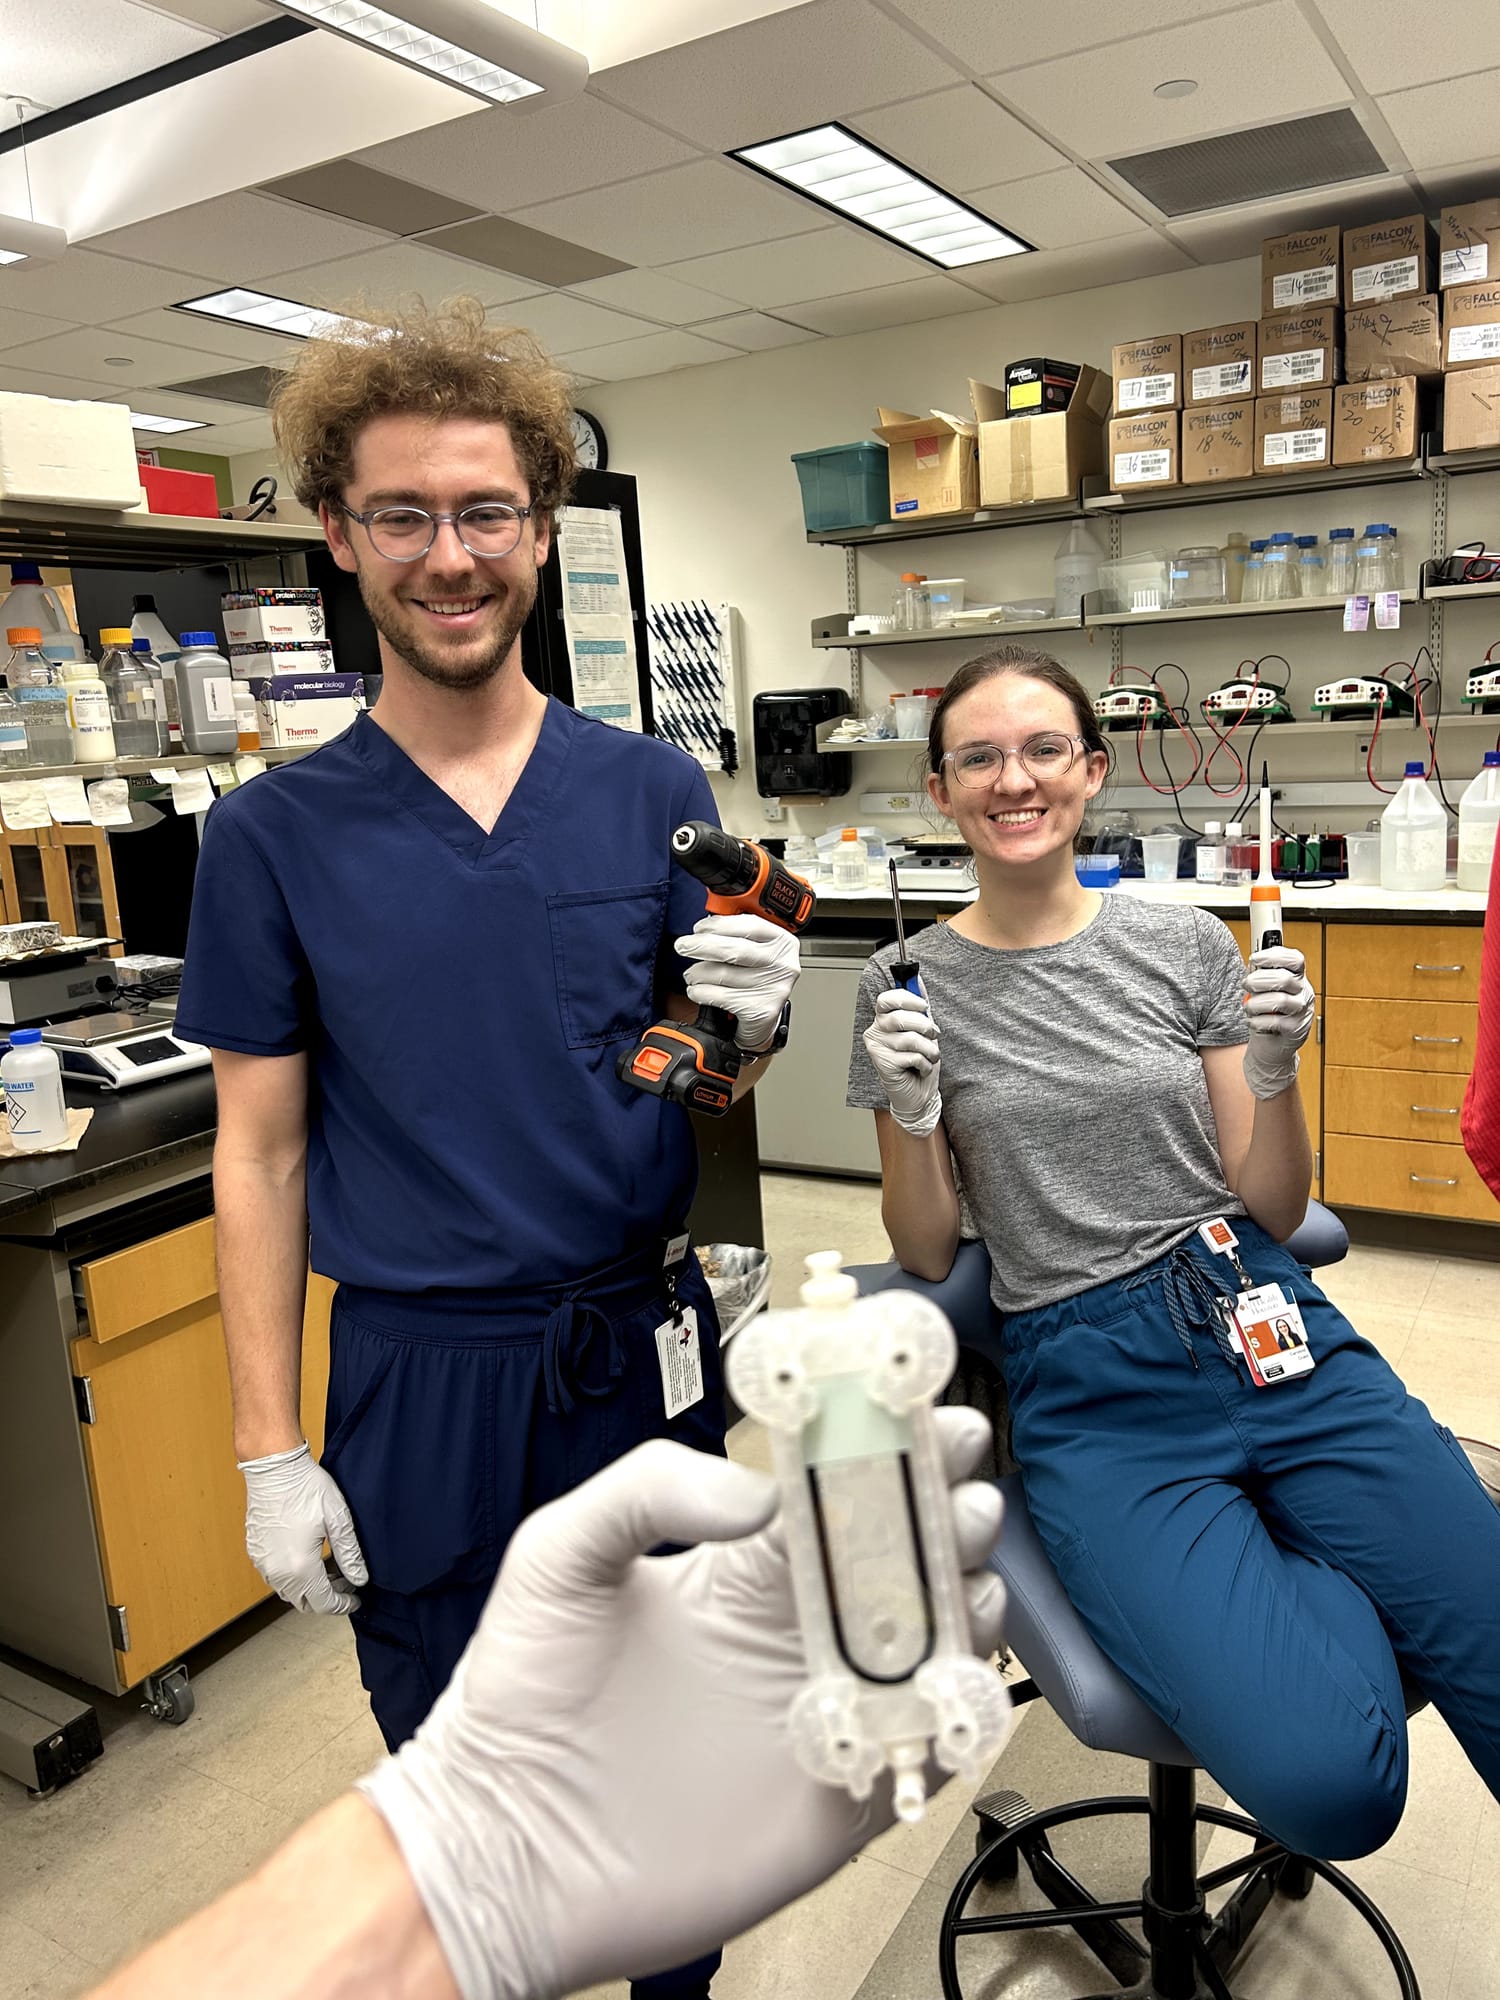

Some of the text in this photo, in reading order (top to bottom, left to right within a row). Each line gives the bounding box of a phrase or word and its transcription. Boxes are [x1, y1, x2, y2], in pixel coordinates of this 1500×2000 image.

[1370, 225, 1414, 242] FALCON
[1287, 235, 1328, 250] FALCON
[1283, 317, 1323, 332] FALCON
[1207, 331, 1245, 346] FALCON
[1135, 343, 1172, 358] FALCON
[1360, 387, 1402, 400] FALCON
[1282, 398, 1321, 412] FALCON
[1205, 410, 1244, 424] FALCON
[1343, 410, 1363, 425] 20
[1132, 420, 1168, 434] FALCON
[585, 430, 591, 441] 2
[589, 444, 596, 456] 3
[1196, 434, 1213, 453] 18
[275, 592, 296, 600] protein
[285, 728, 318, 736] Thermo
[771, 889, 794, 905] DECKER
[1250, 1336, 1261, 1349] S
